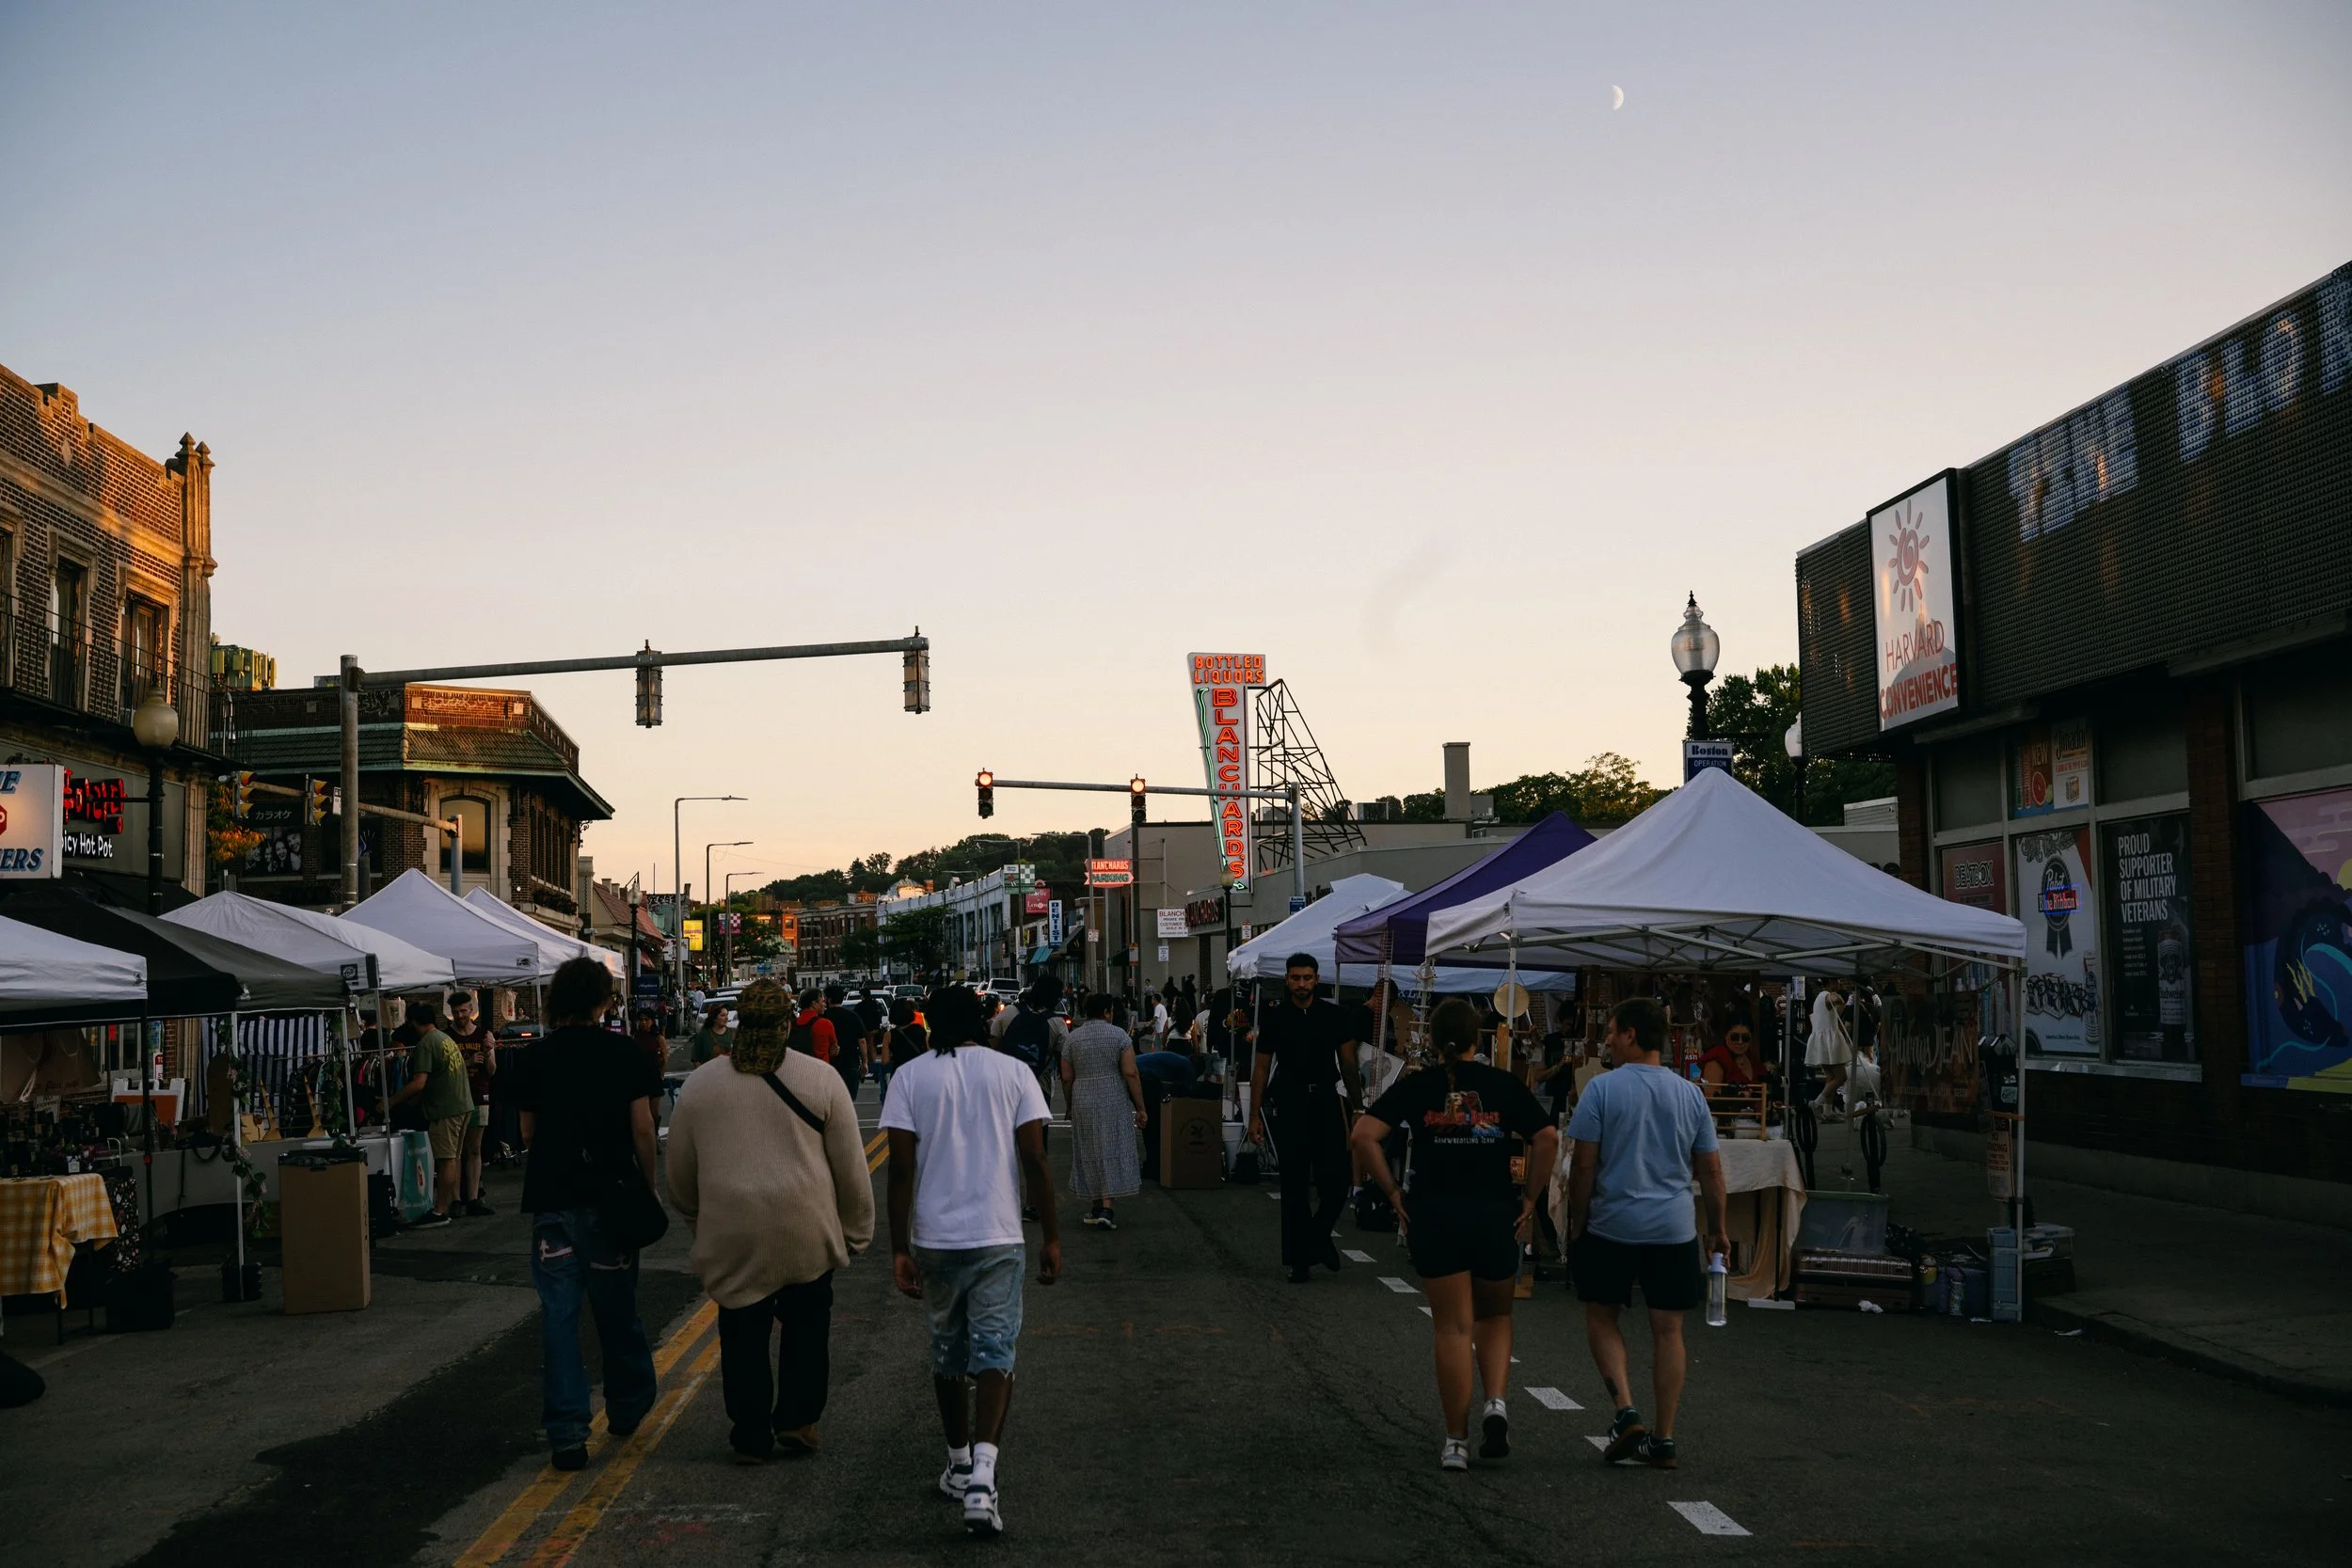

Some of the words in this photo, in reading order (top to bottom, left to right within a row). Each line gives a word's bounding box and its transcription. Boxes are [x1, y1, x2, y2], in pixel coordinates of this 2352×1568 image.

[1885, 620, 1945, 673] HARVARD
[1194, 655, 1263, 670] BOTTLED
[1193, 669, 1264, 685] LIQUORS
[1880, 662, 1958, 721] CONVENIENCE
[1692, 744, 1728, 756] Boston
[1693, 759, 1727, 768] OPERATION
[255, 810, 294, 821] カラオケ
[79, 832, 96, 856] Hot
[97, 835, 113, 858] Pot
[2118, 832, 2150, 857] PROUD
[0, 848, 43, 871] ERS
[2119, 852, 2174, 879] SUPPORTER
[1954, 859, 1994, 890] BEATBOX
[2121, 879, 2133, 901] OF
[2134, 875, 2176, 899] MILITARY
[1051, 902, 1060, 942] DENTIST
[2121, 898, 2169, 924] VETERANS
